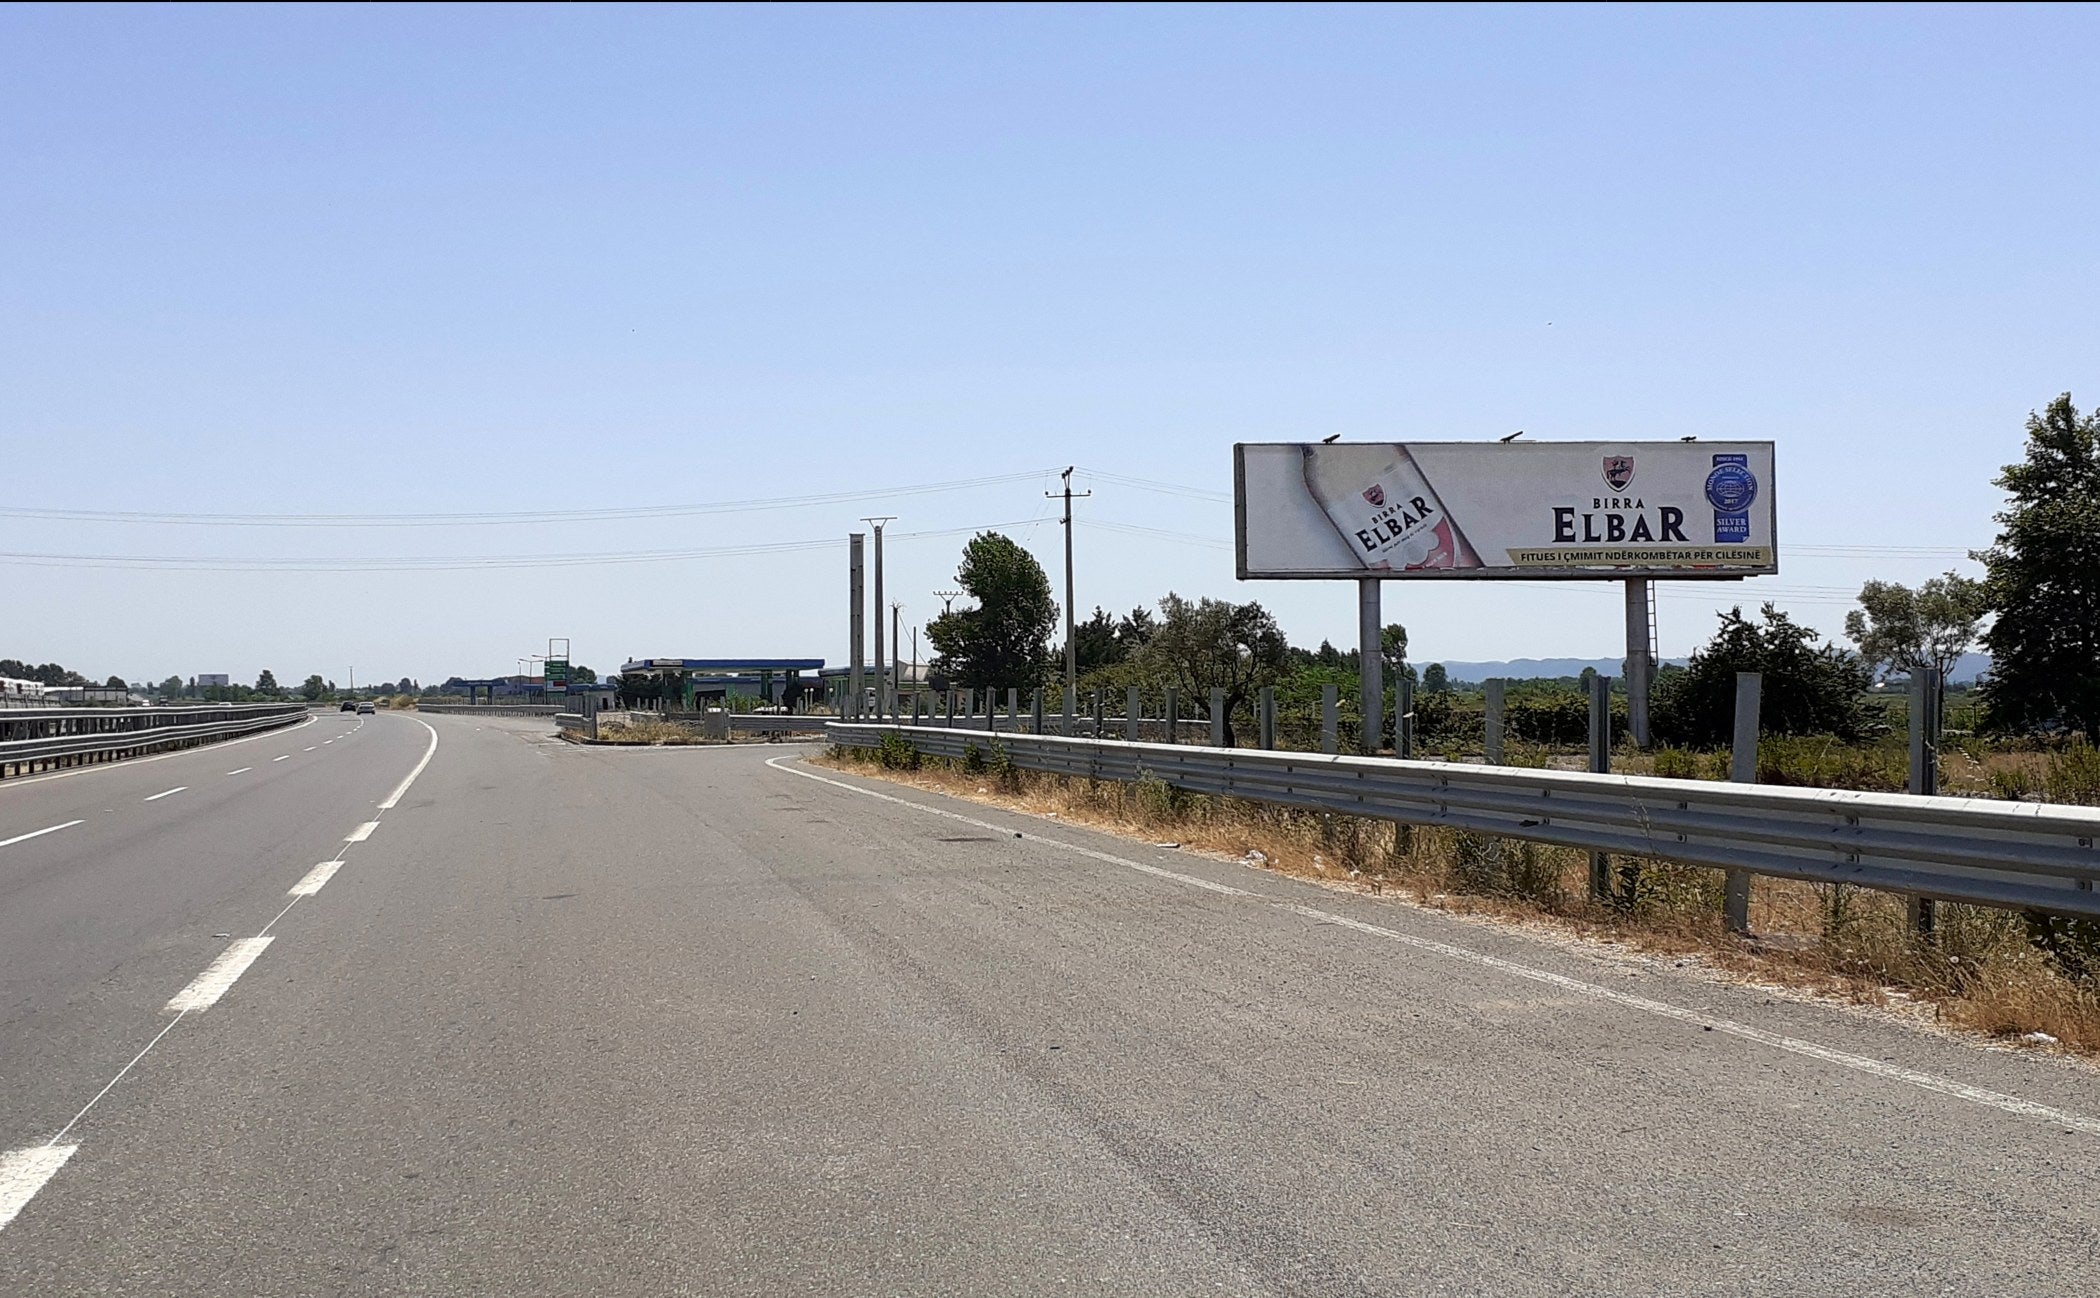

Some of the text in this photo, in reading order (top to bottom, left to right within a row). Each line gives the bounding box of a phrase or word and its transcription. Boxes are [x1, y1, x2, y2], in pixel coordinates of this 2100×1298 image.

[1593, 498, 1645, 509] BIRRA
[1371, 503, 1403, 524] BIRRA
[1716, 518, 1747, 526] SILVER
[1354, 496, 1435, 552] ELBAR
[1551, 507, 1690, 543] ELBAR
[1521, 549, 1761, 563] FITUES I ÇMIMIT NDËRKOMBËTAR PËR CILËSINË
